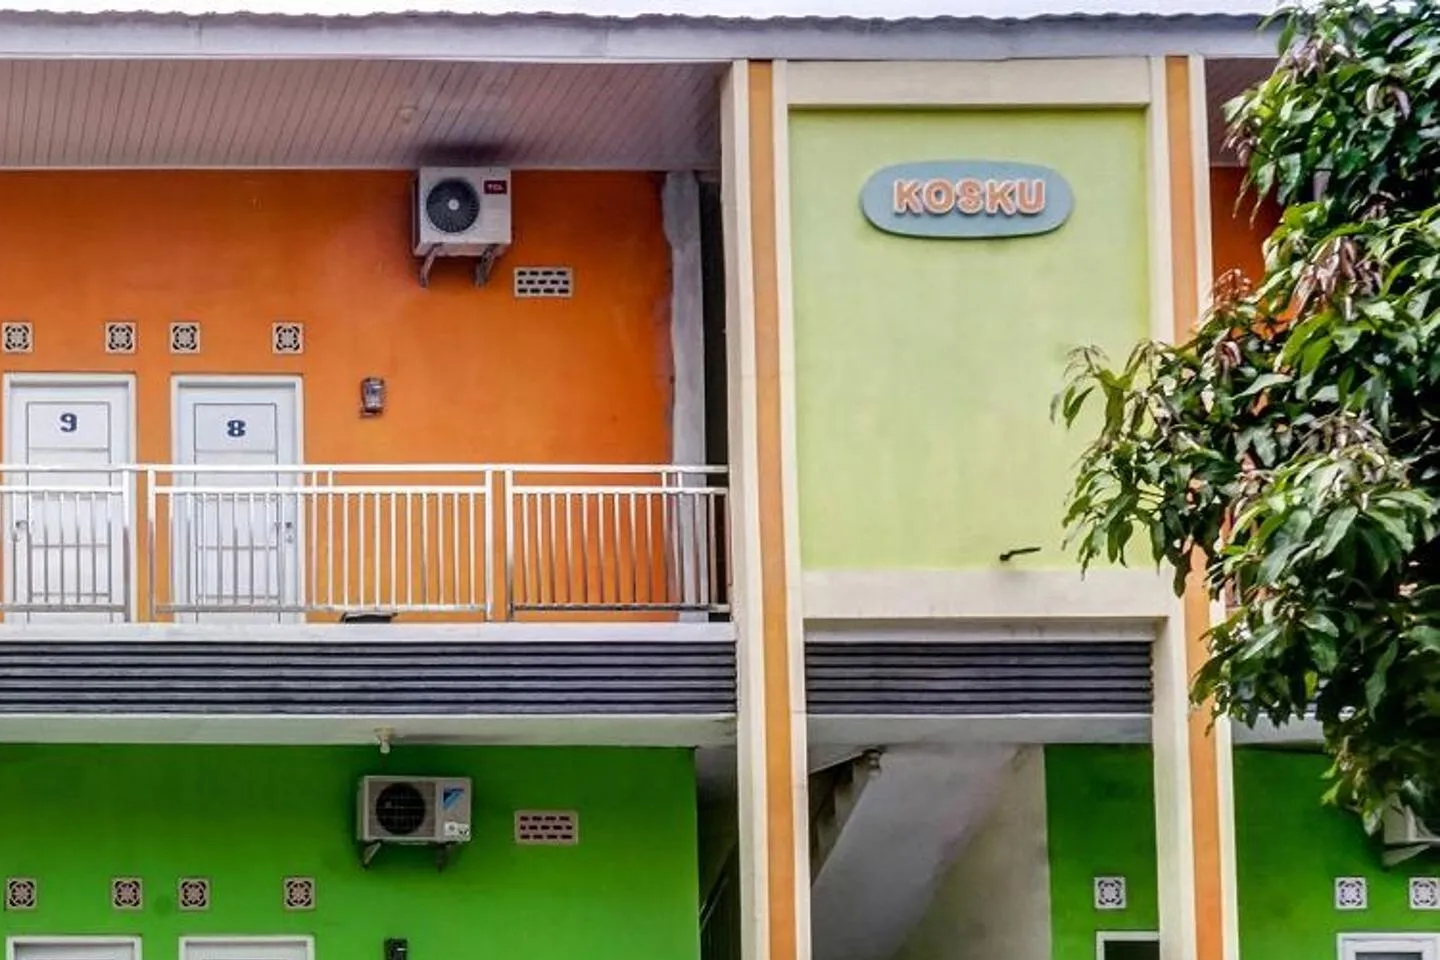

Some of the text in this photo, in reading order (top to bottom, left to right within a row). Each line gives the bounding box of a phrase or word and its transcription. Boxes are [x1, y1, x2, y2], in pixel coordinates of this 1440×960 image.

[894, 178, 1046, 216] KOSKU
[59, 412, 78, 433] 9
[226, 419, 247, 438] 8
